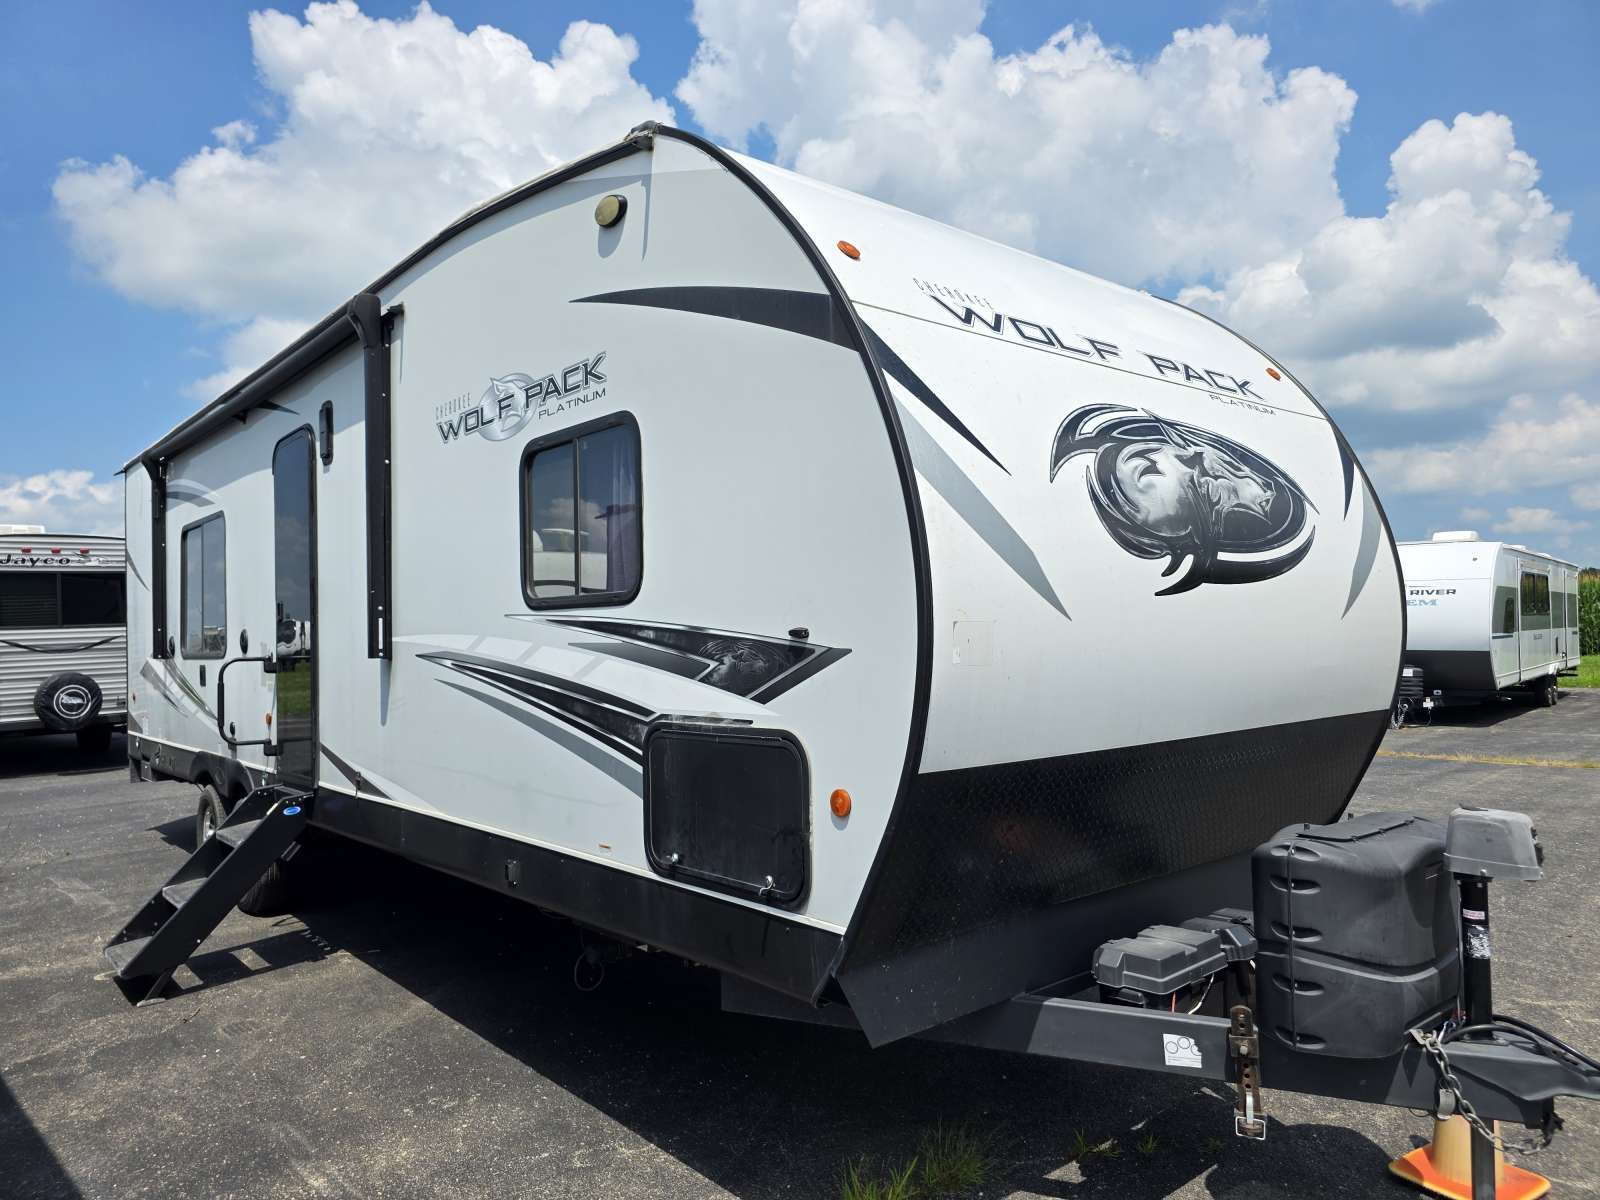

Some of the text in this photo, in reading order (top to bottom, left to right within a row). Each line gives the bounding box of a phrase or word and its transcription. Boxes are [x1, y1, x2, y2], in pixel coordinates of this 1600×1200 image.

[926, 292, 1266, 402] WOLF PACK
[436, 350, 607, 444] WOLF PACK
[538, 387, 607, 420] PLATINUM
[1208, 393, 1277, 416] PLATINUM
[0, 553, 71, 568] Jayco
[1409, 588, 1457, 596] RIVER
